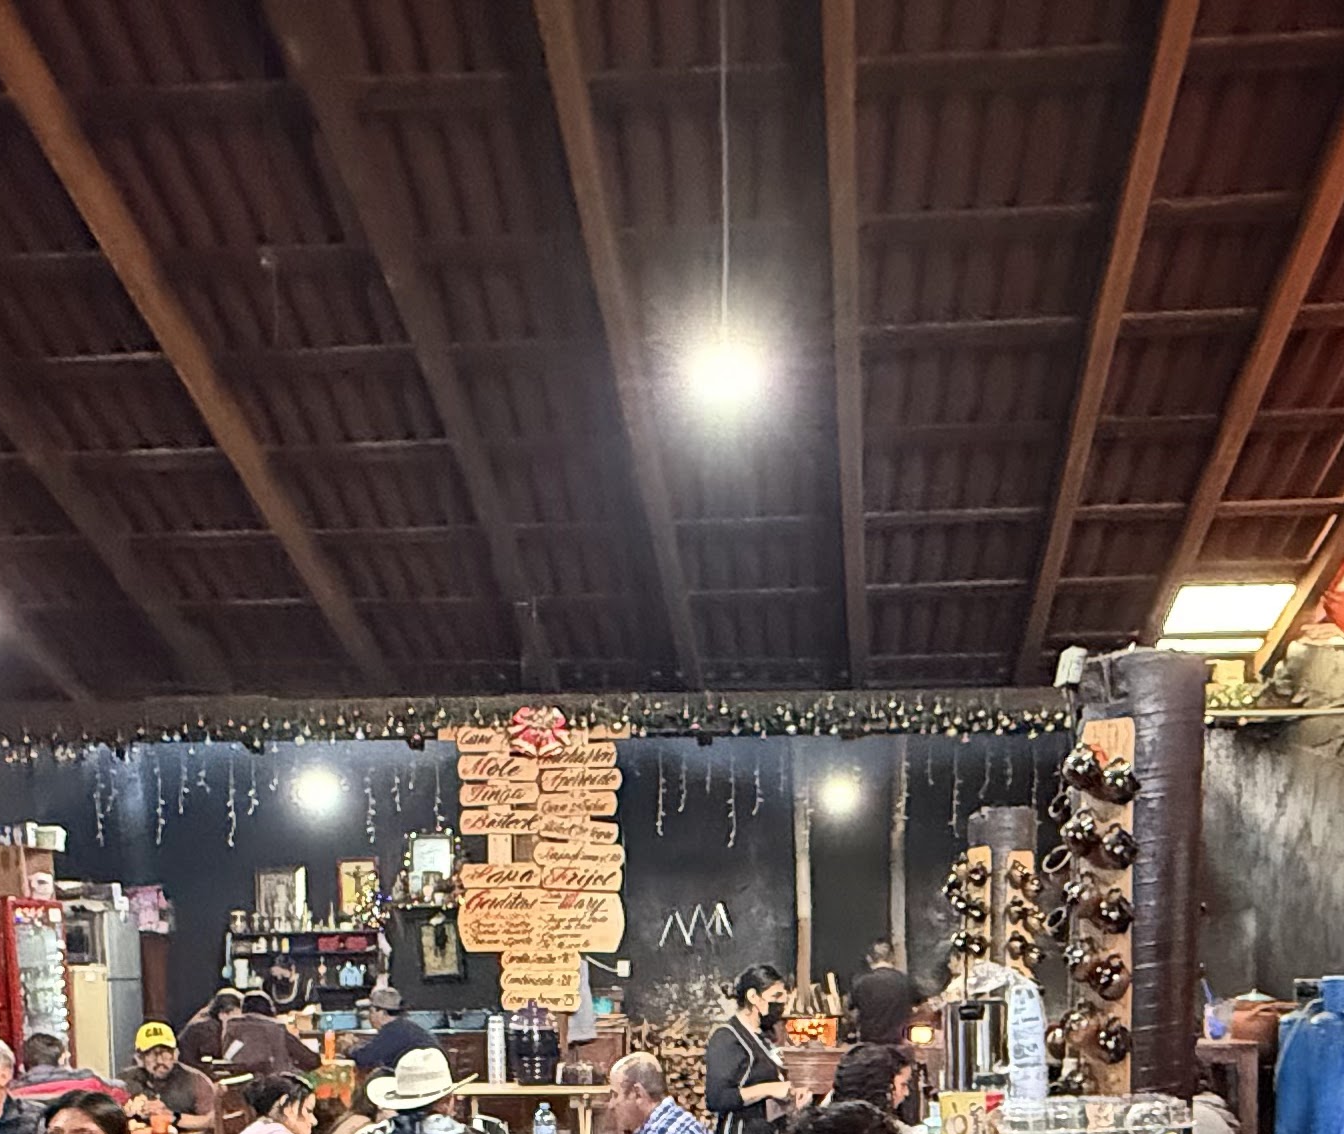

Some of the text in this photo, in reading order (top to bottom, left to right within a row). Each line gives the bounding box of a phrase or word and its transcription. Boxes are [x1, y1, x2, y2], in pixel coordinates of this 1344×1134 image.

[462, 757, 523, 777] Mole
[466, 785, 526, 804] Tinga
[466, 864, 534, 886] Papa
[544, 867, 617, 889] Frijol
[464, 889, 538, 914] Gorditas
